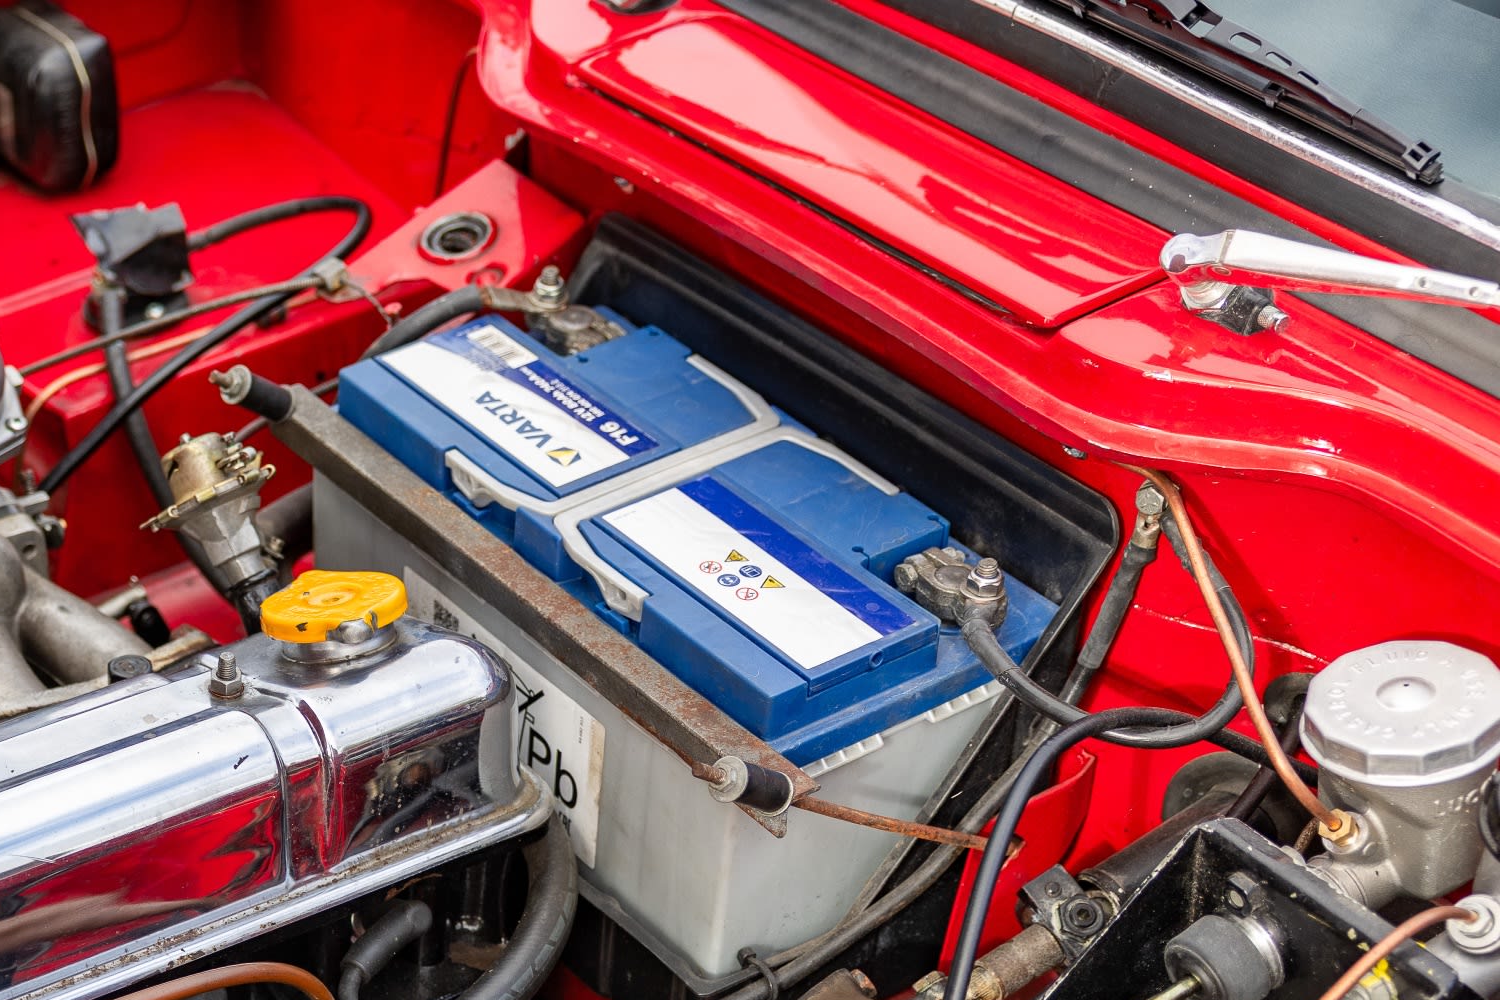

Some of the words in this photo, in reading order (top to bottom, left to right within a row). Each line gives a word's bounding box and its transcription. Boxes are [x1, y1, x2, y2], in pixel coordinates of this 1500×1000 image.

[476, 391, 552, 448] VARTA
[600, 421, 639, 446] F16
[1349, 651, 1428, 674] FLUID
[528, 728, 578, 809] Pb
